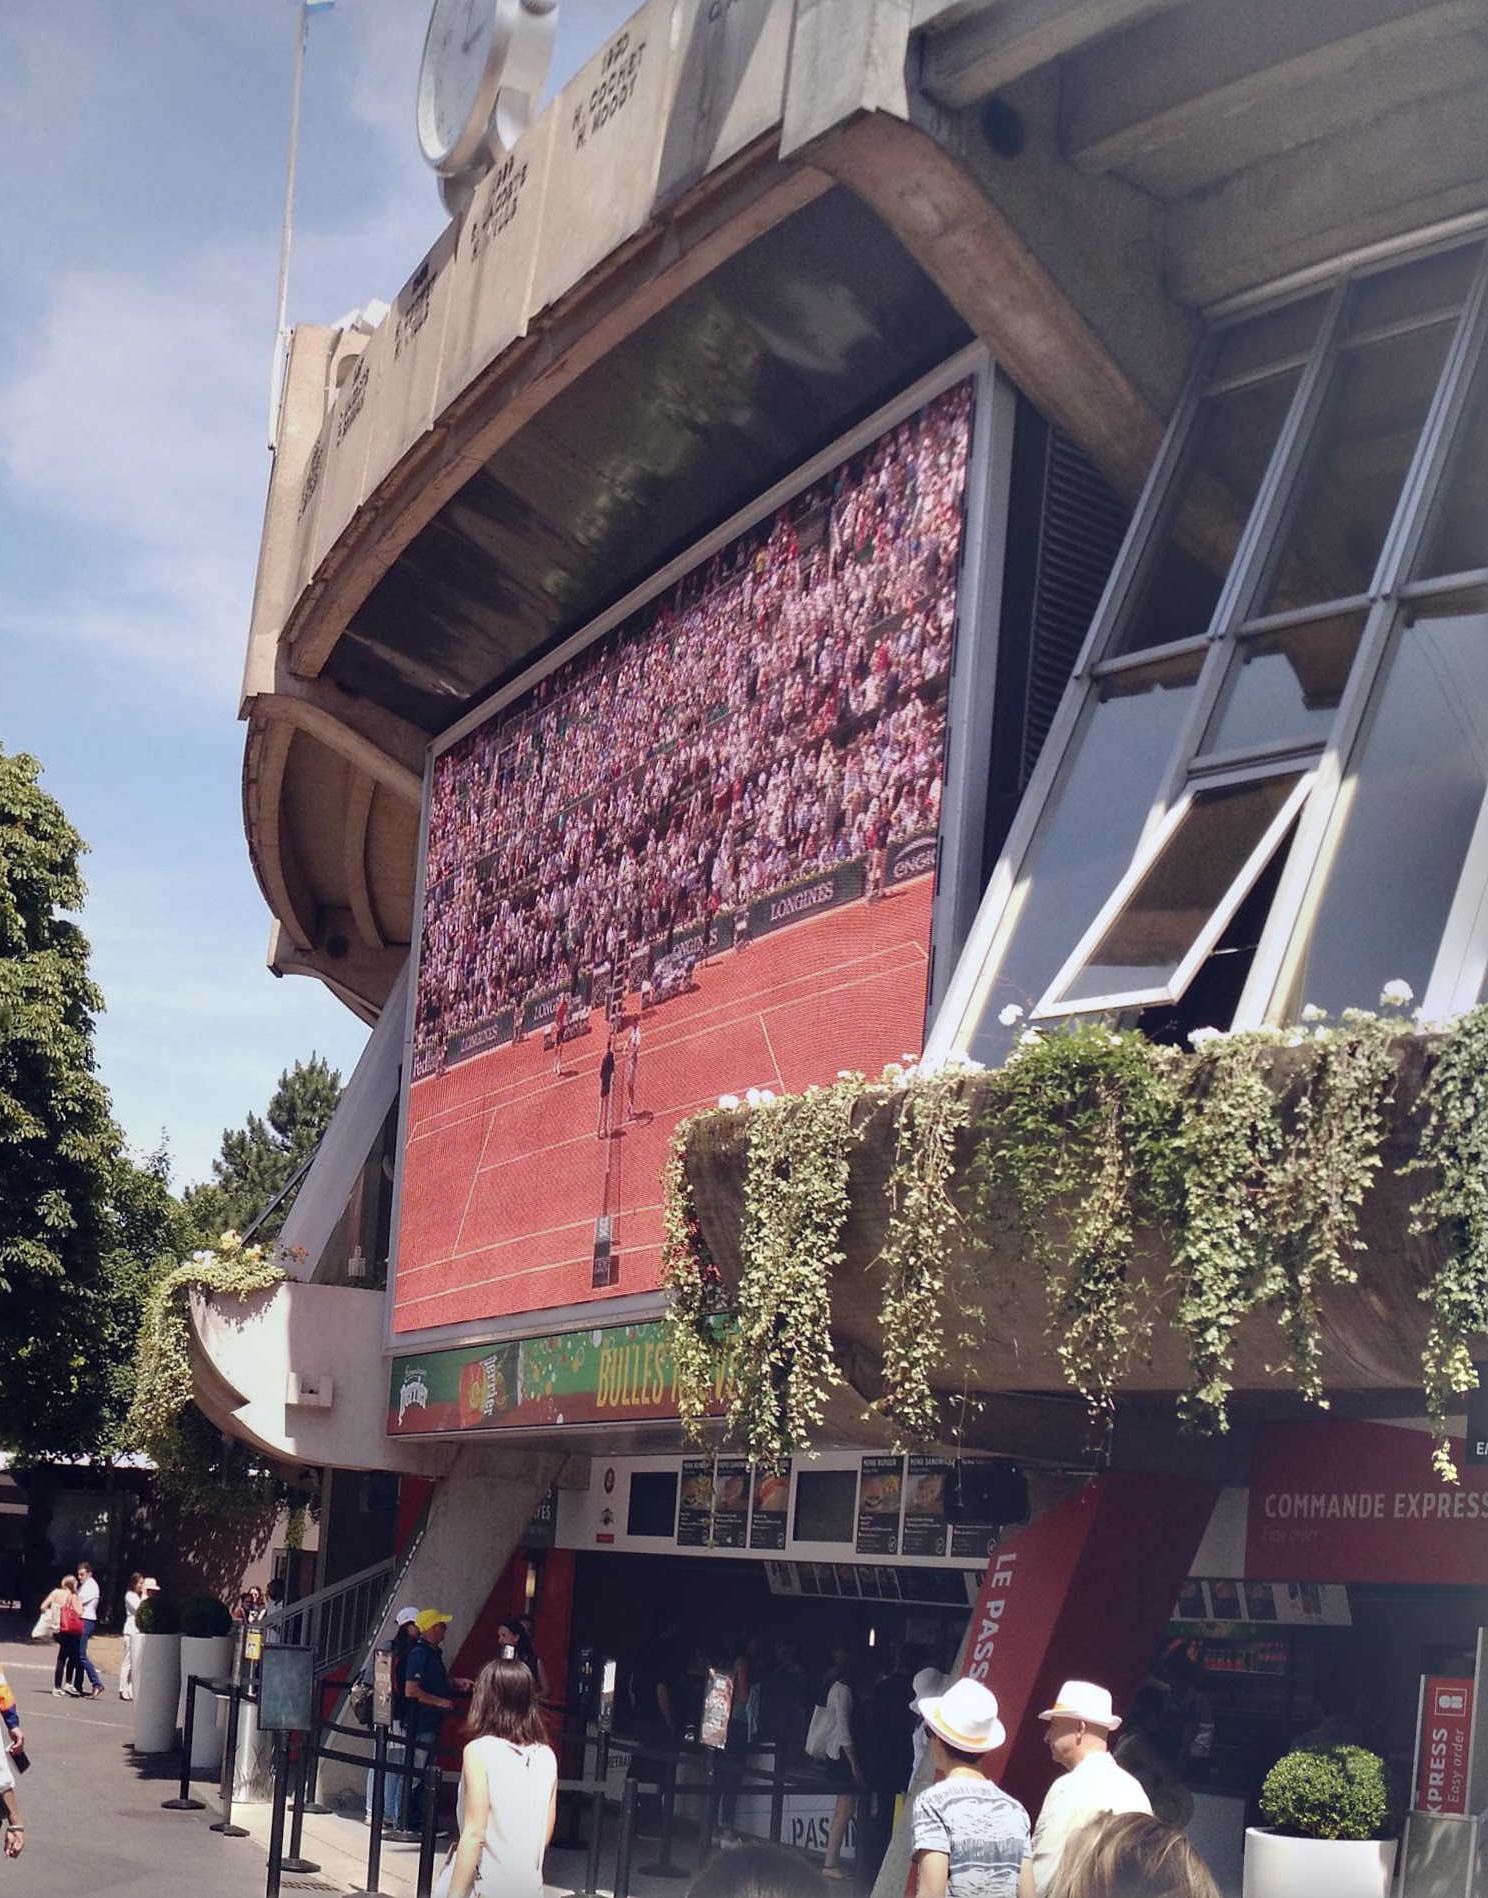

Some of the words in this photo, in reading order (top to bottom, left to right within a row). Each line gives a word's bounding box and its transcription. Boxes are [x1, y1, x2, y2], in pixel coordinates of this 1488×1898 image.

[770, 879, 835, 921] LONGINES
[596, 1341, 665, 1408] BULLES
[1264, 1493, 1385, 1519] COMMANDE
[991, 1553, 1017, 1589] LE
[1451, 1728, 1465, 1767] order
[1448, 1771, 1464, 1804] Easy
